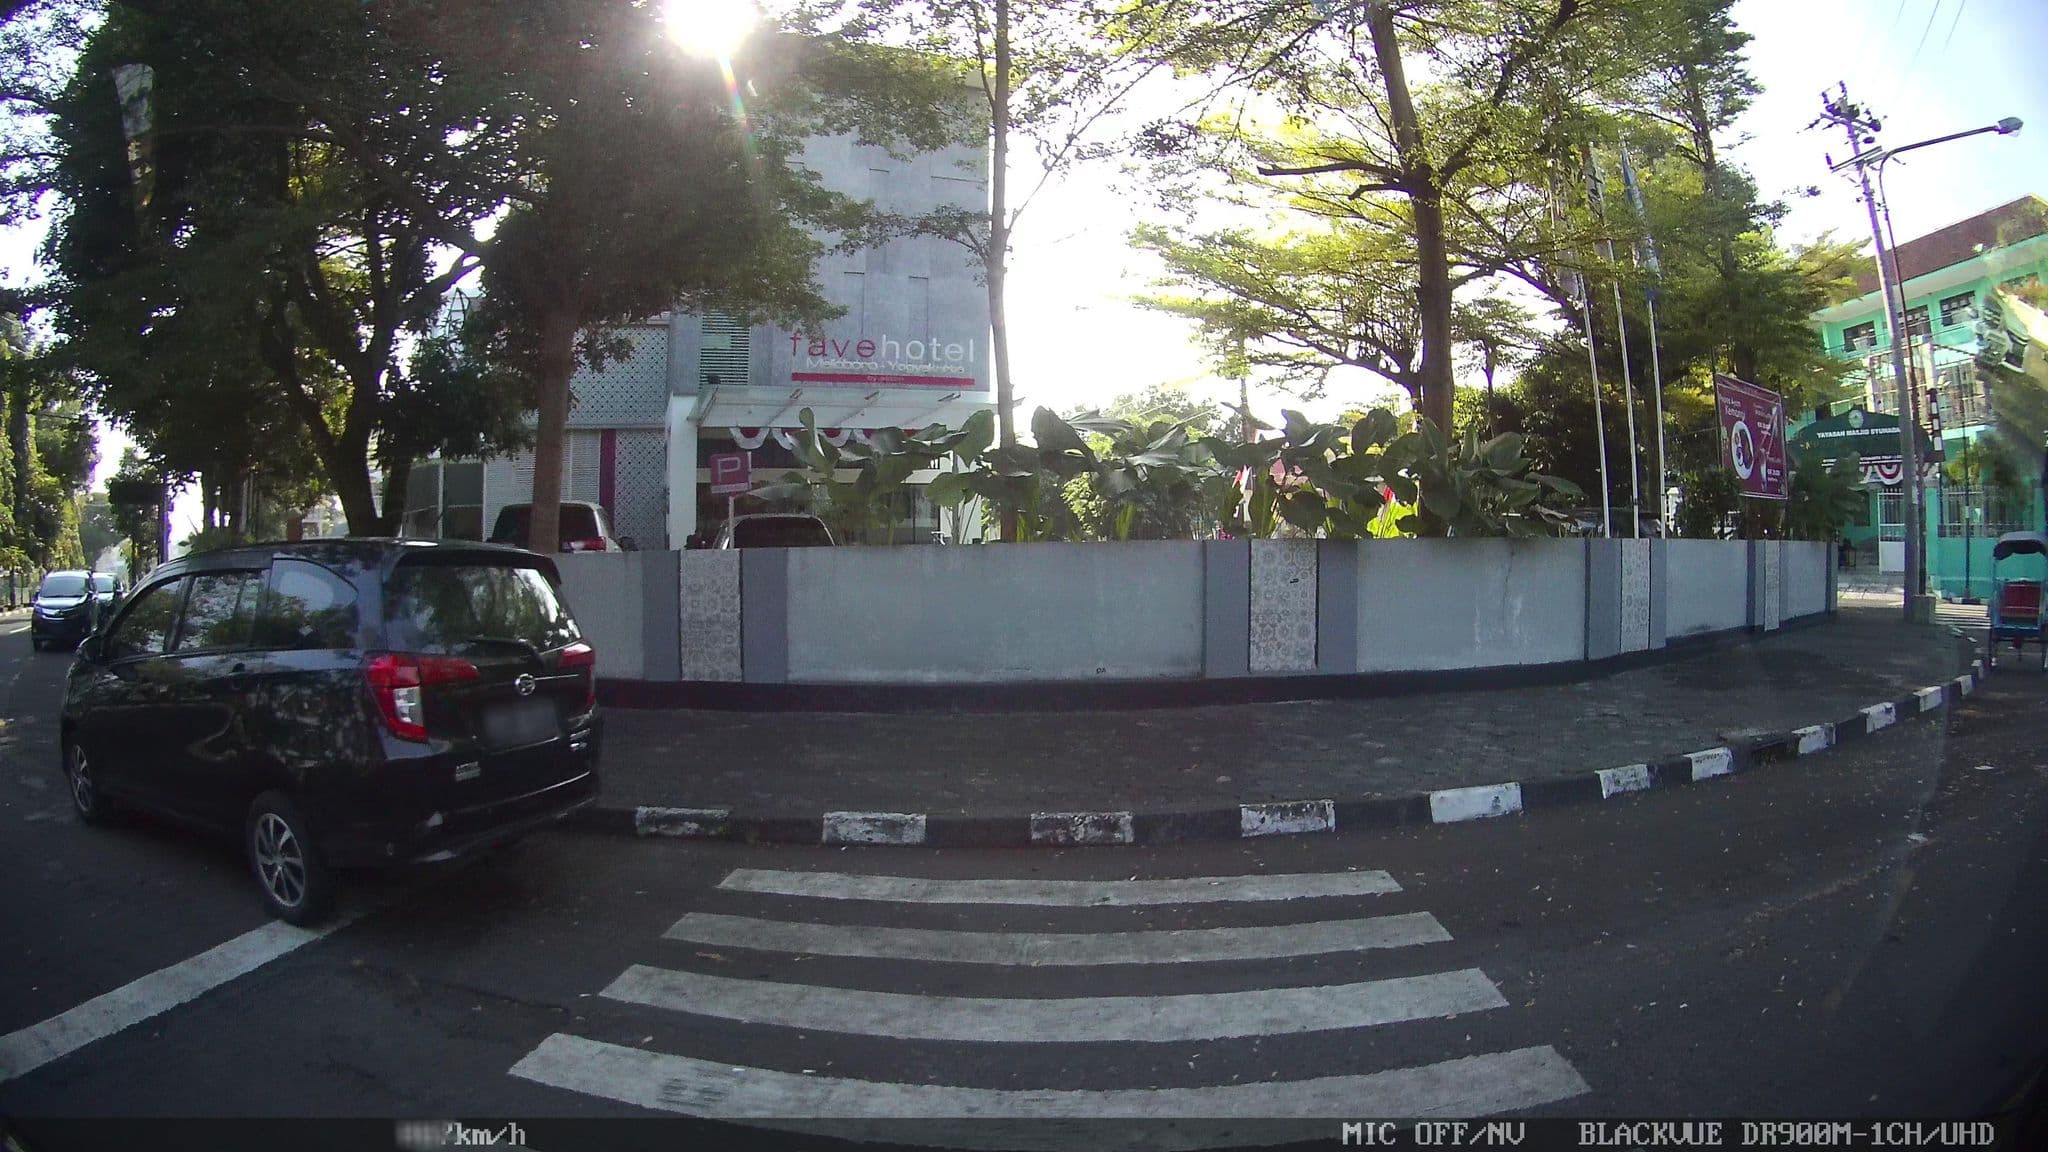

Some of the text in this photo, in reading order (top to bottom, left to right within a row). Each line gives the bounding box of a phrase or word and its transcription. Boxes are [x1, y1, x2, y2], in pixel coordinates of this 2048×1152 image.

[790, 331, 975, 363] favehotel
[1817, 430, 1846, 439] YAYASAN
[718, 456, 741, 482] P
